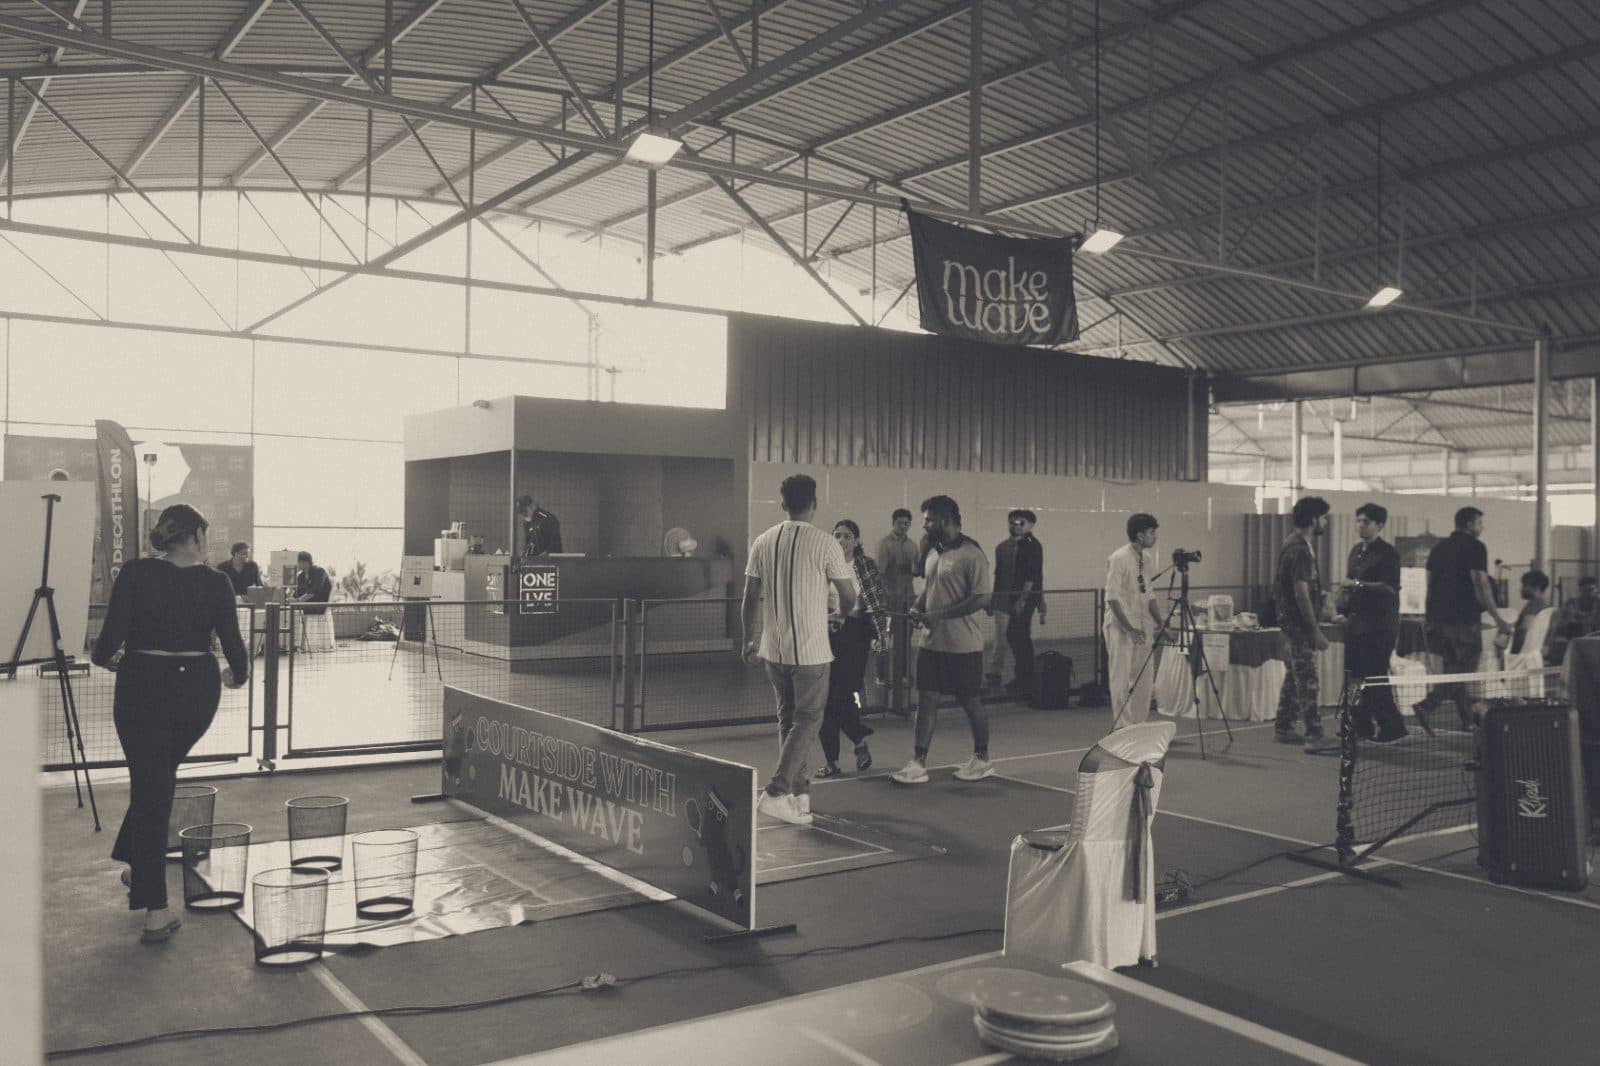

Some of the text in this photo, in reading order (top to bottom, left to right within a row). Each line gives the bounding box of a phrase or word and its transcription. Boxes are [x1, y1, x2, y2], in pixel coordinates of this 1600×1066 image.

[943, 256, 1049, 301] make
[110, 448, 124, 564] DECATHLON
[522, 572, 556, 588] ONE
[474, 716, 677, 817] COURTSIDE WITH
[499, 763, 645, 856] MAKE WAVE
